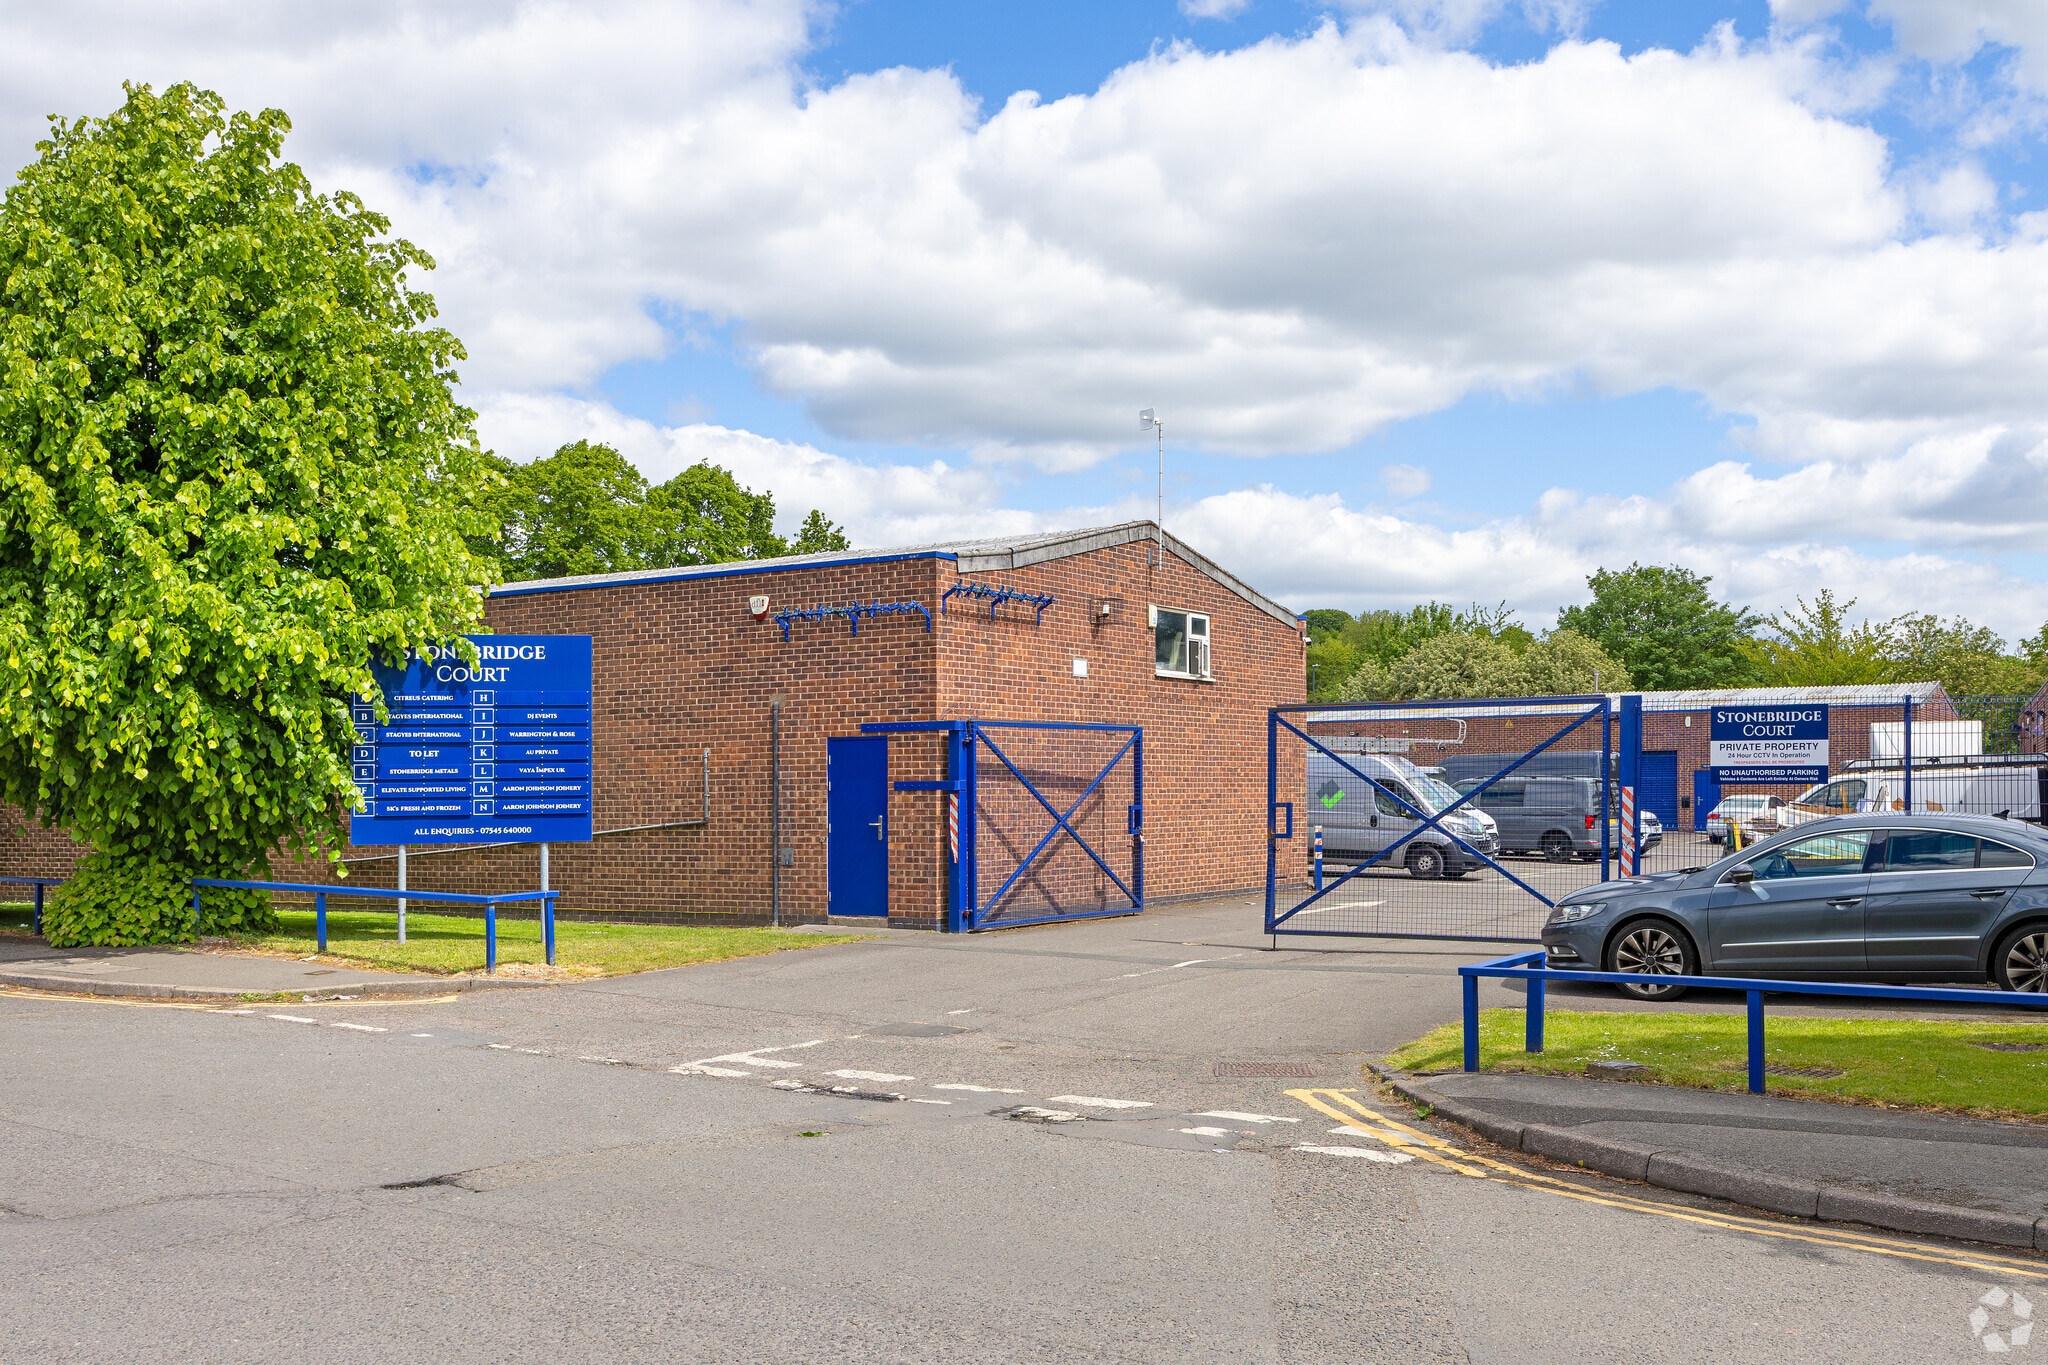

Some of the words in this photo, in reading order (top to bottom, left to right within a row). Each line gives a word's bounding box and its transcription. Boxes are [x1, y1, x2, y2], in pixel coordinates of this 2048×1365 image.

[402, 646, 546, 660] STONBRIDGE
[436, 666, 510, 682] COURT
[1717, 711, 1822, 723] STONEBRIDGE
[1743, 725, 1795, 736] COURT
[431, 828, 474, 836] ENQUIRIES
